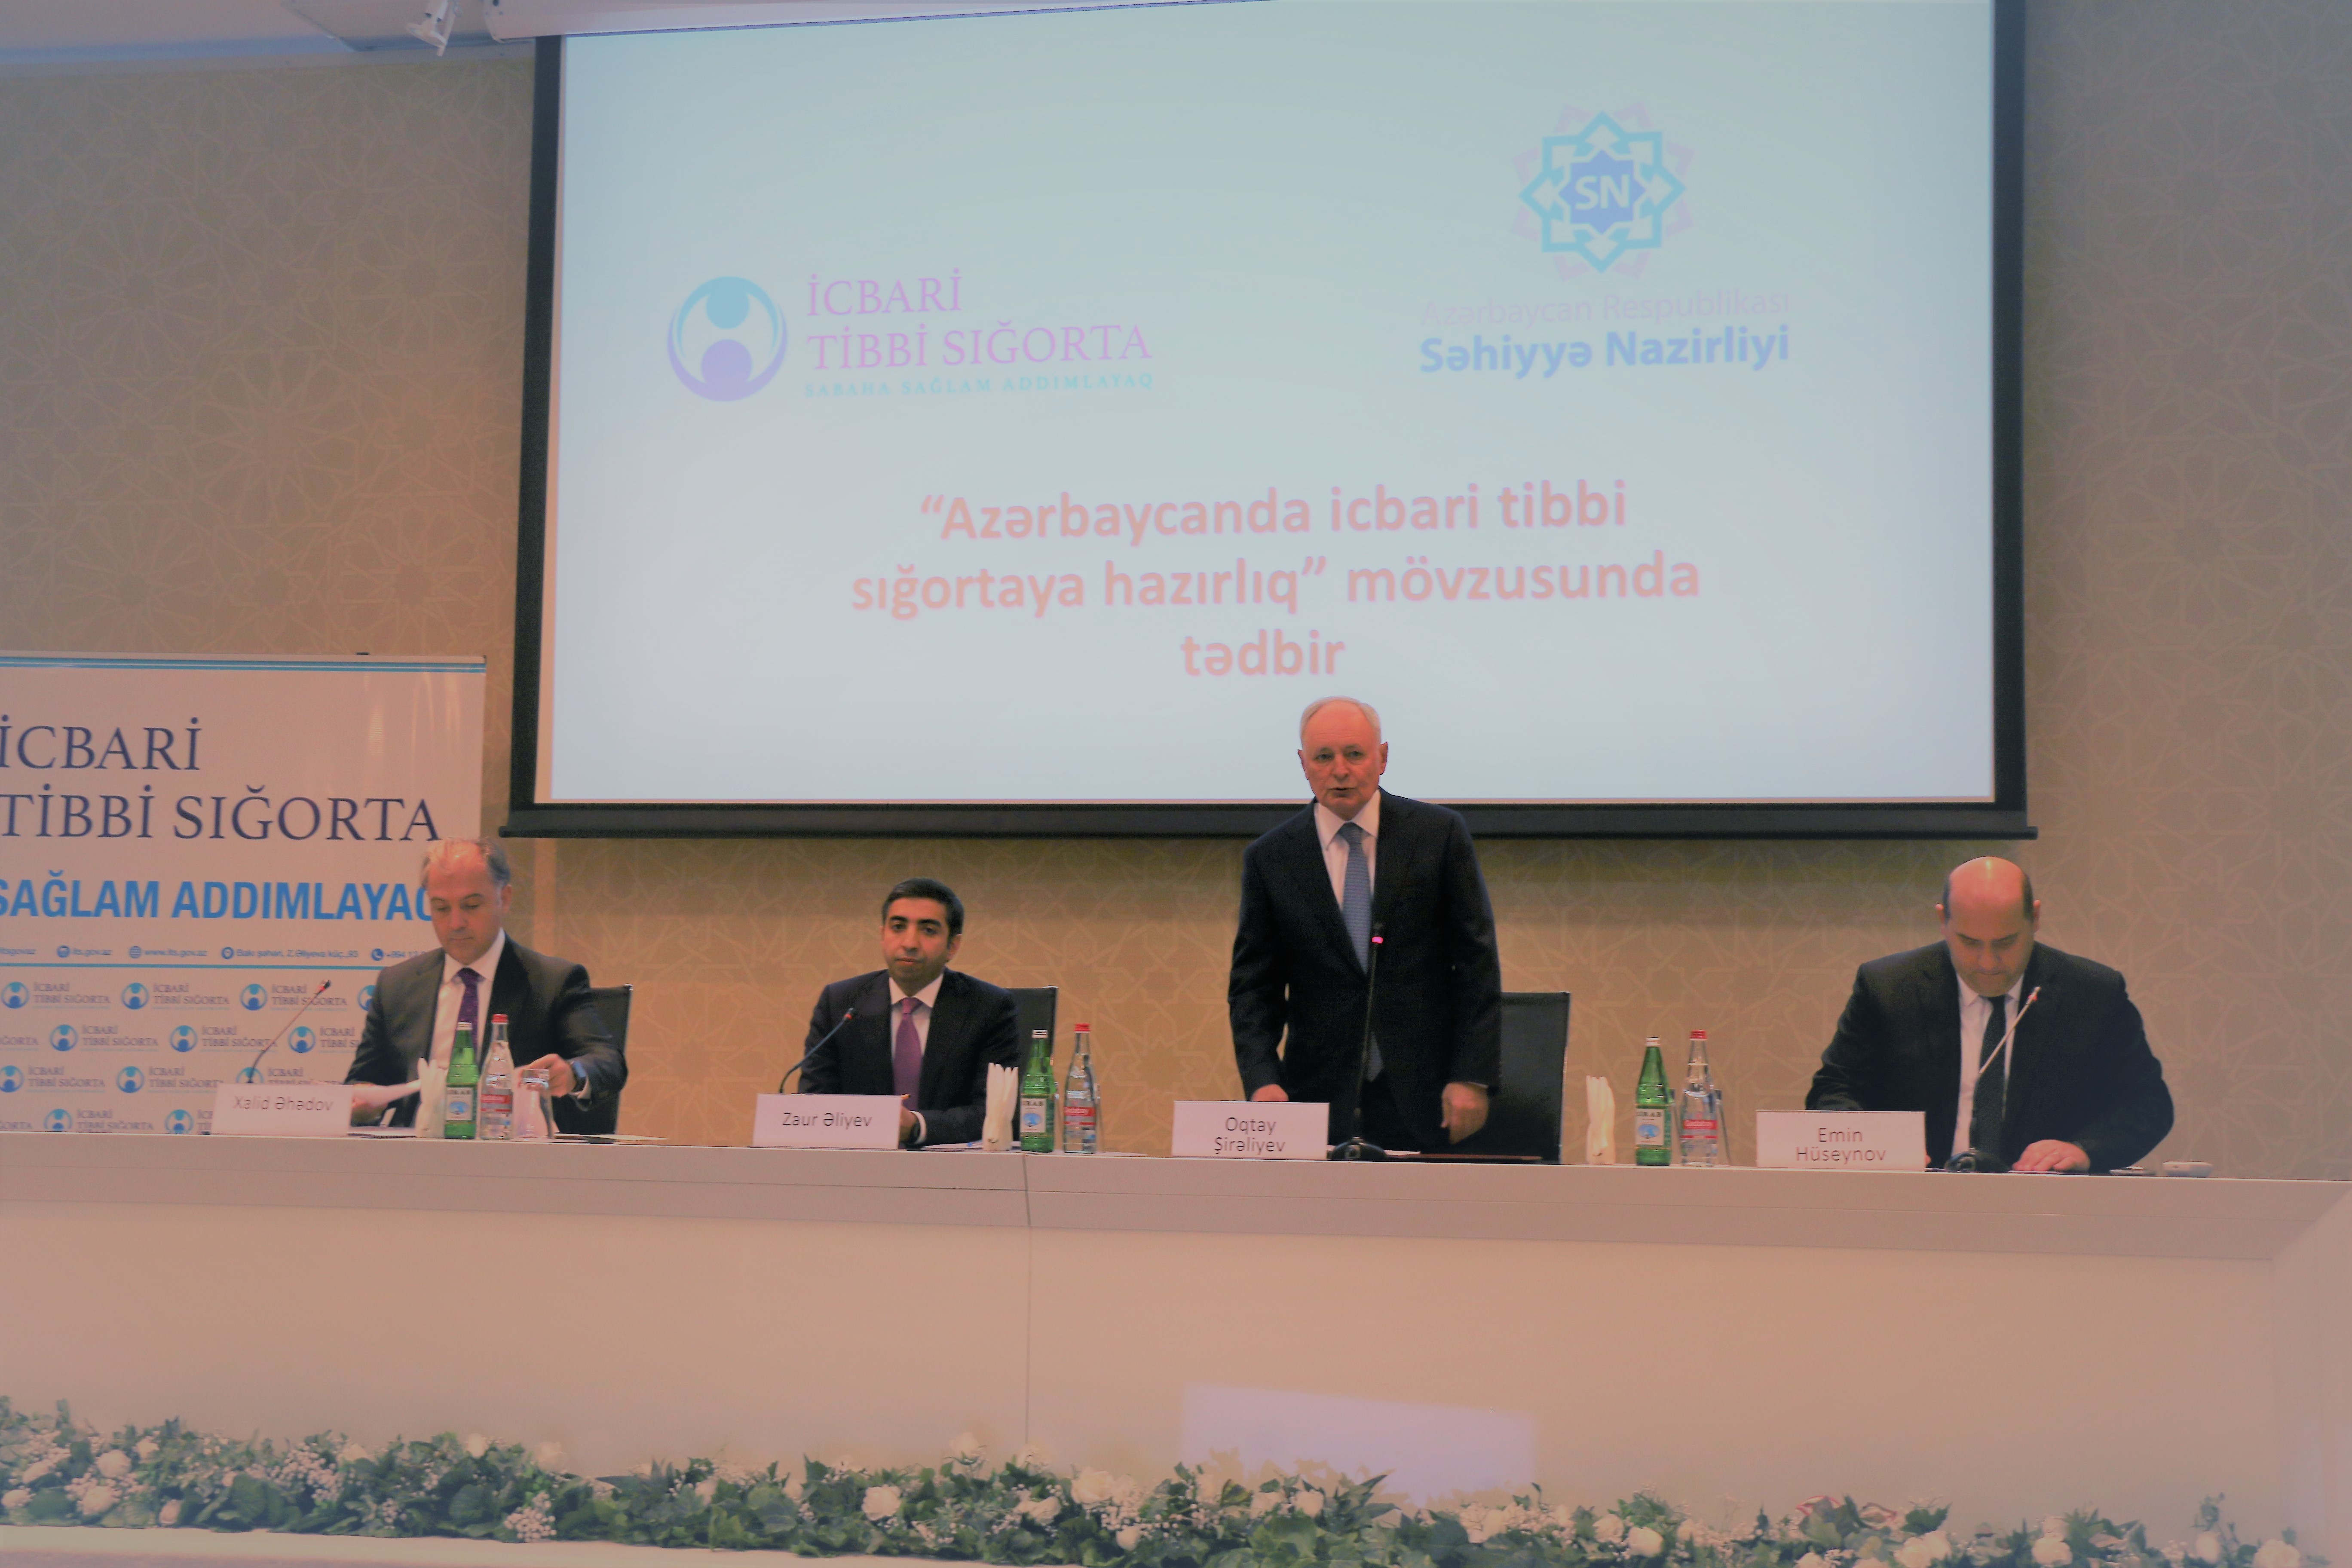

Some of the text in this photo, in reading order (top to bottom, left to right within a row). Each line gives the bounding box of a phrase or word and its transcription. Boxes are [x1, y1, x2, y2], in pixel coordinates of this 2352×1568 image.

[1575, 175, 1629, 209] SN
[807, 268, 962, 316] İCBARİ
[1421, 288, 1789, 330] Azərbaycan Respublikası
[806, 319, 1153, 370] TİBBİ SIĞORTA
[1420, 324, 1788, 380] Səhiyyə Nazirliyi
[805, 373, 1154, 397] SABAHA SAĞLAM ADDIMLAYAQ
[1330, 484, 1479, 533] icbari
[1497, 480, 1626, 528] tibbi
[851, 563, 1084, 620] sığortaya
[1347, 549, 1700, 602] mövzusunda
[1180, 629, 1345, 676] tədbir
[0, 714, 201, 770] İCBARİ
[0, 783, 440, 841] TİBBİ SIĞORTA
[233, 1096, 334, 1110] Xalid Əhədov
[782, 1112, 873, 1130] Zaur Əliyev
[1214, 1137, 1286, 1155] Şirəliyev
[1225, 1117, 1277, 1135] Oqtay
[1818, 1128, 1863, 1142] Emin
[1796, 1146, 1886, 1164] Hüseynov
